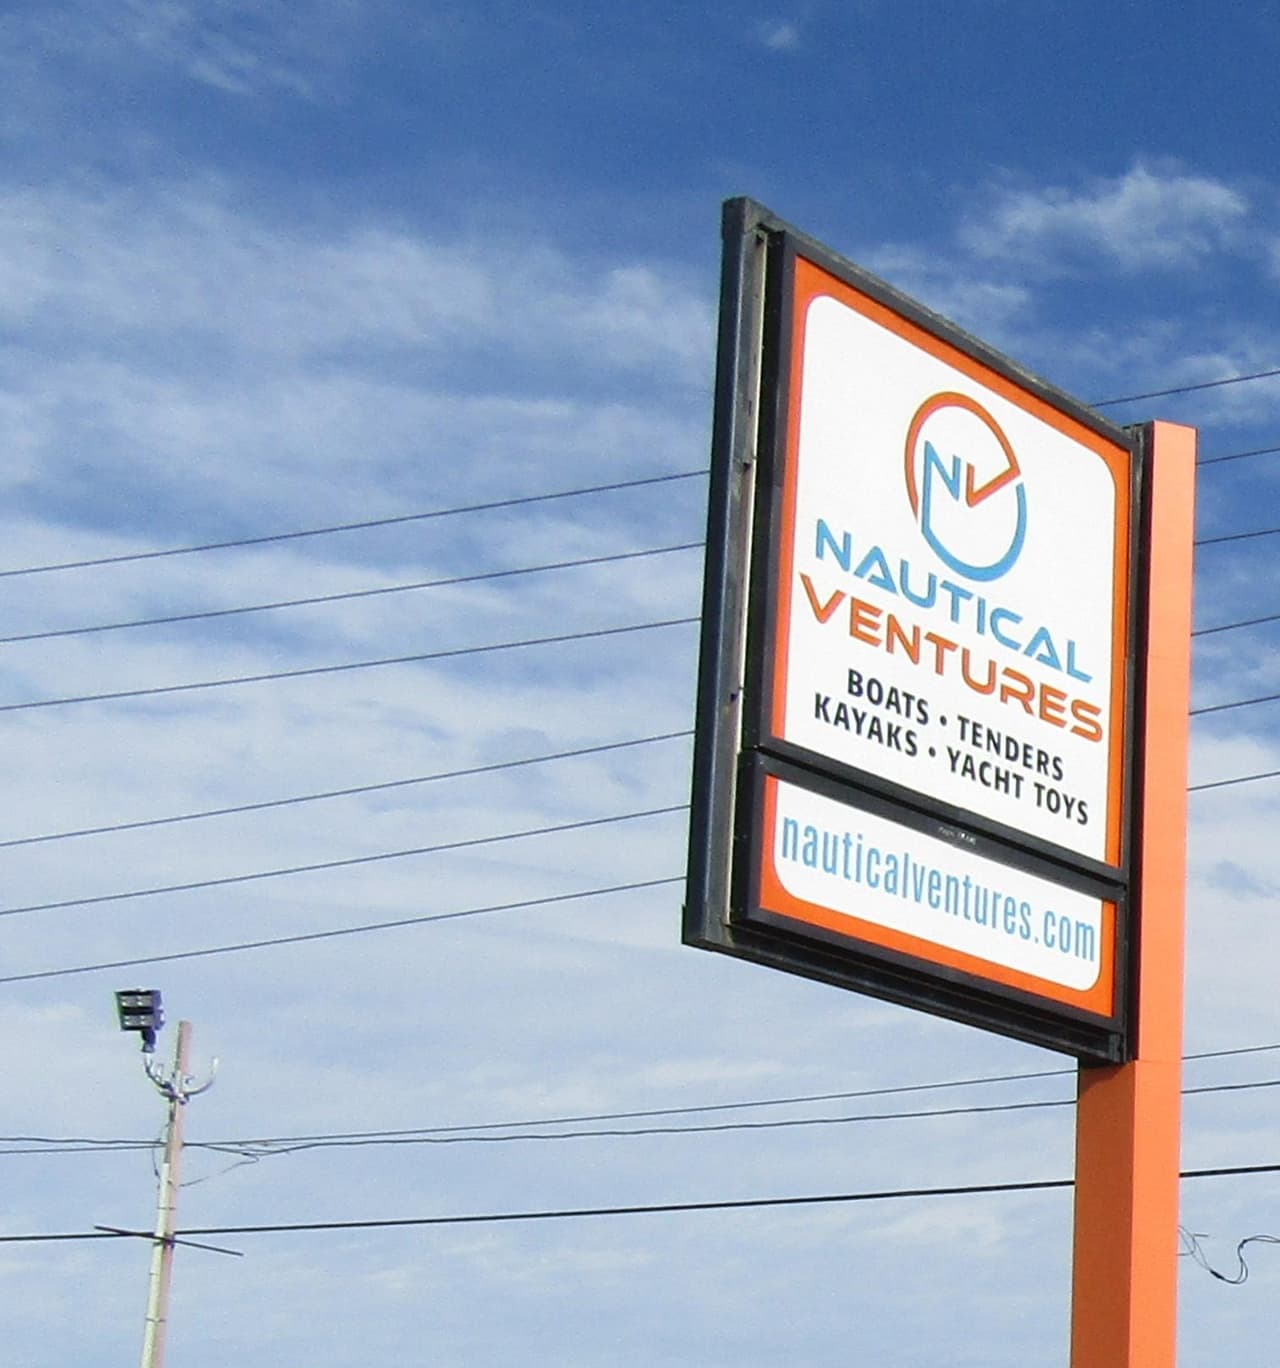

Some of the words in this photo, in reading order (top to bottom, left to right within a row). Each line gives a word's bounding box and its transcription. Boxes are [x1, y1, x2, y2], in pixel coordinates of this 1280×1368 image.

[800, 572, 1103, 743] VENTURES
[815, 518, 1093, 683] NAUTICAL
[813, 693, 918, 758] KAYAKS
[947, 746, 1024, 799] YACHT
[1034, 782, 1089, 826] TOYS
[847, 668, 929, 725] BOATS
[957, 715, 1064, 781] TENDERS
[781, 814, 1096, 963] nauticalventures.com
